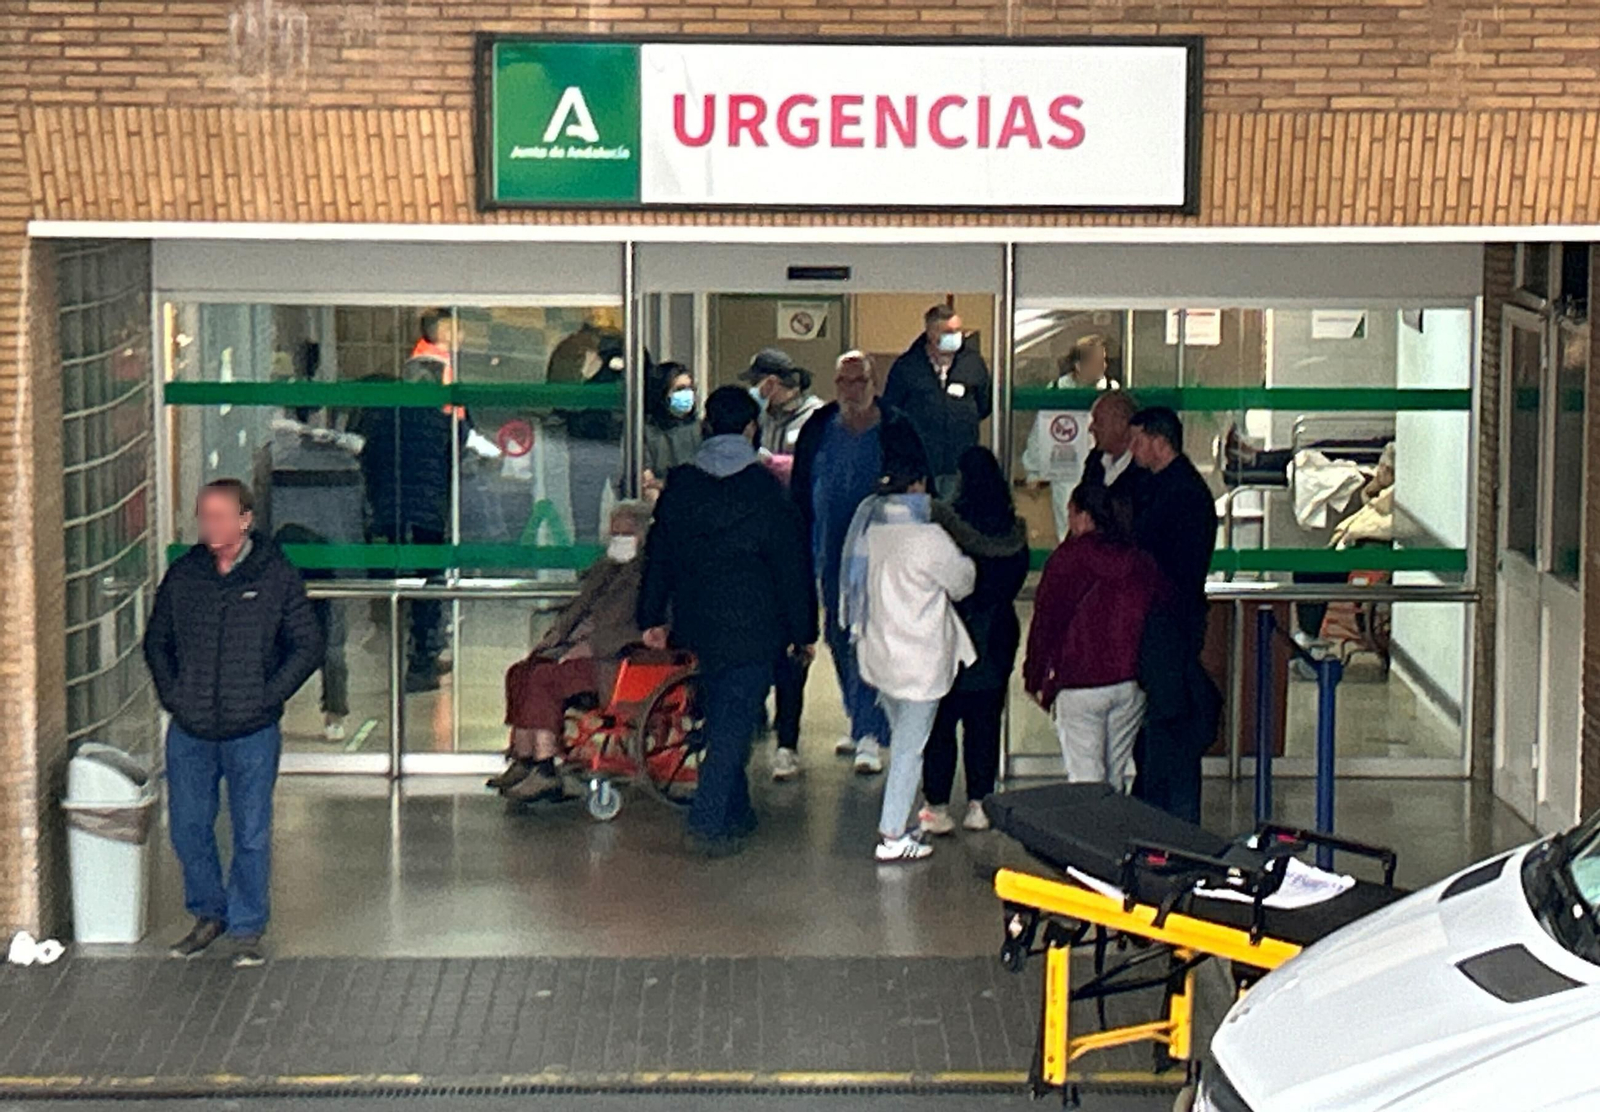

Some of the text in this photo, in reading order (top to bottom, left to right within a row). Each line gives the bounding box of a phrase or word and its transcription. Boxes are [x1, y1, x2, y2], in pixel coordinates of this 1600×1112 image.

[672, 93, 1085, 149] URGENCIAS
[510, 145, 548, 159] Junta
[548, 145, 566, 159] de
